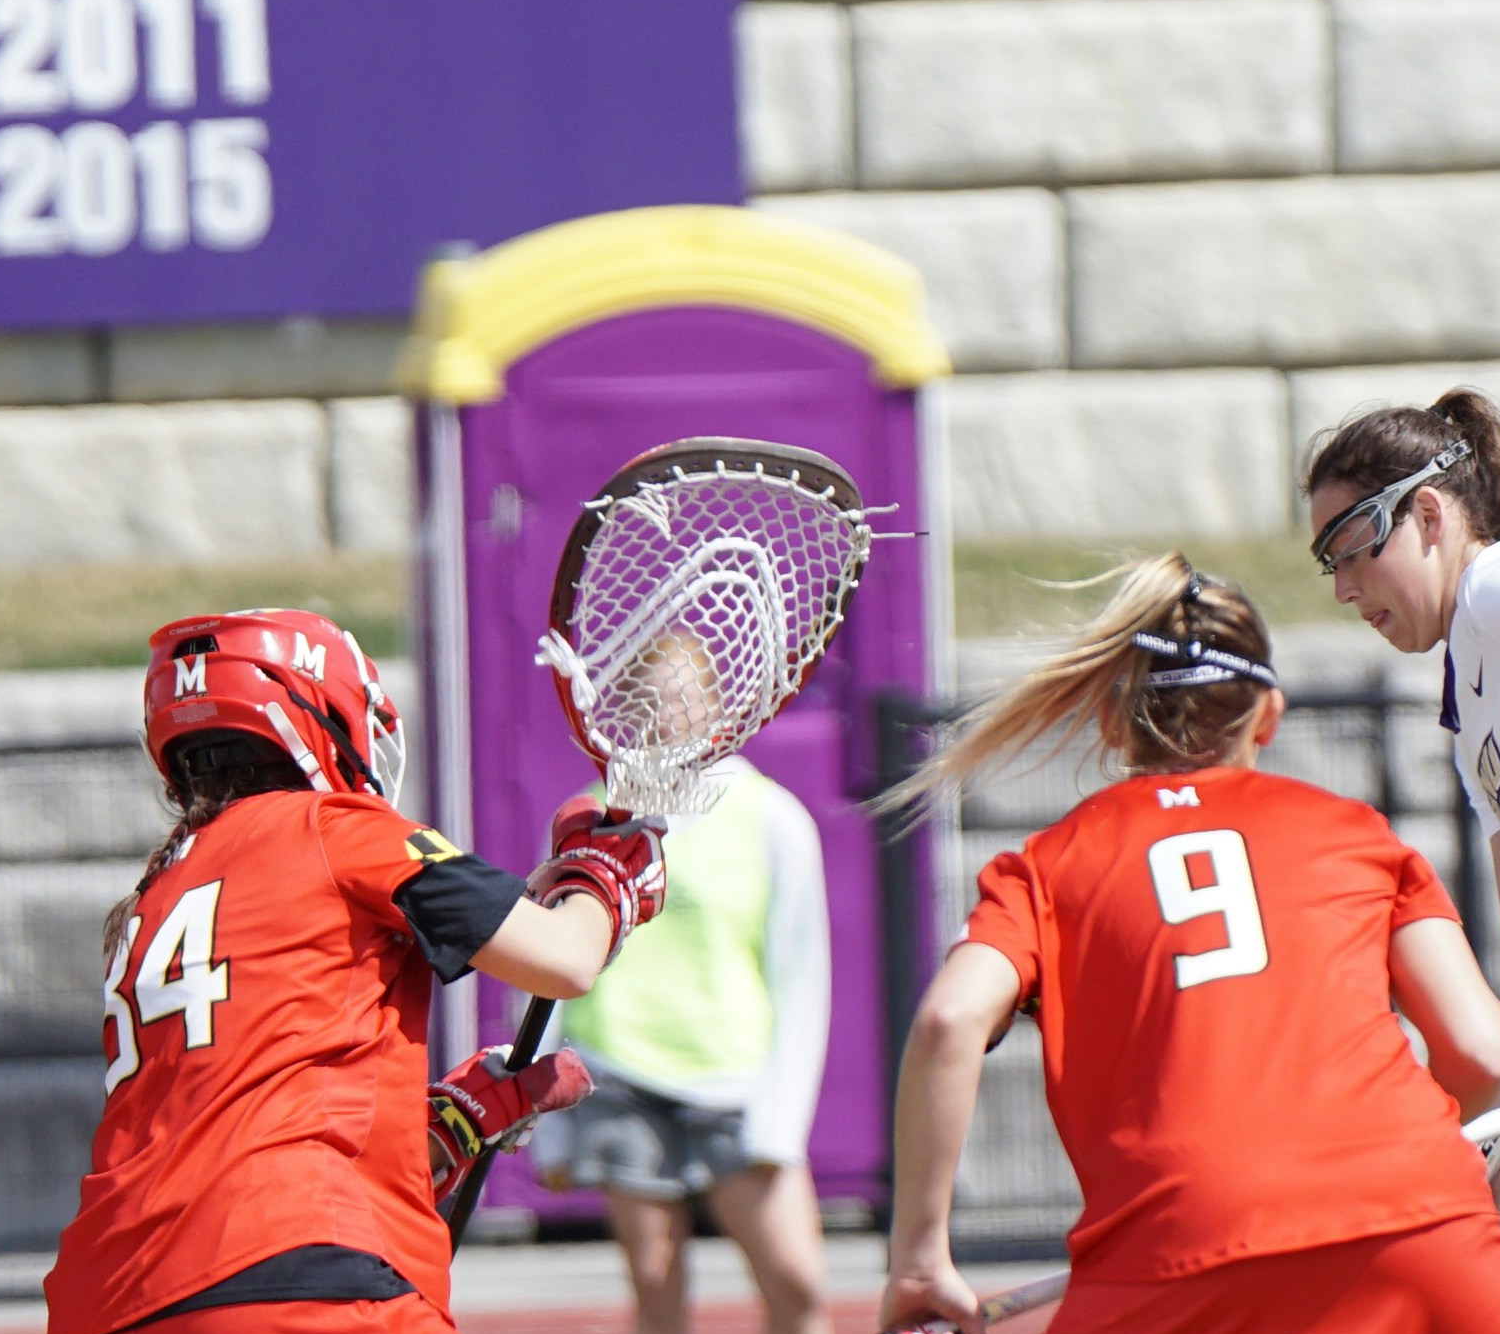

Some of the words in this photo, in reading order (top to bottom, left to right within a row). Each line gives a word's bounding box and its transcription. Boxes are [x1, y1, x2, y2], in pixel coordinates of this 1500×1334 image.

[173, 654, 209, 702] M
[291, 631, 327, 684] M
[1156, 785, 1201, 809] M
[1146, 828, 1270, 991] 9
